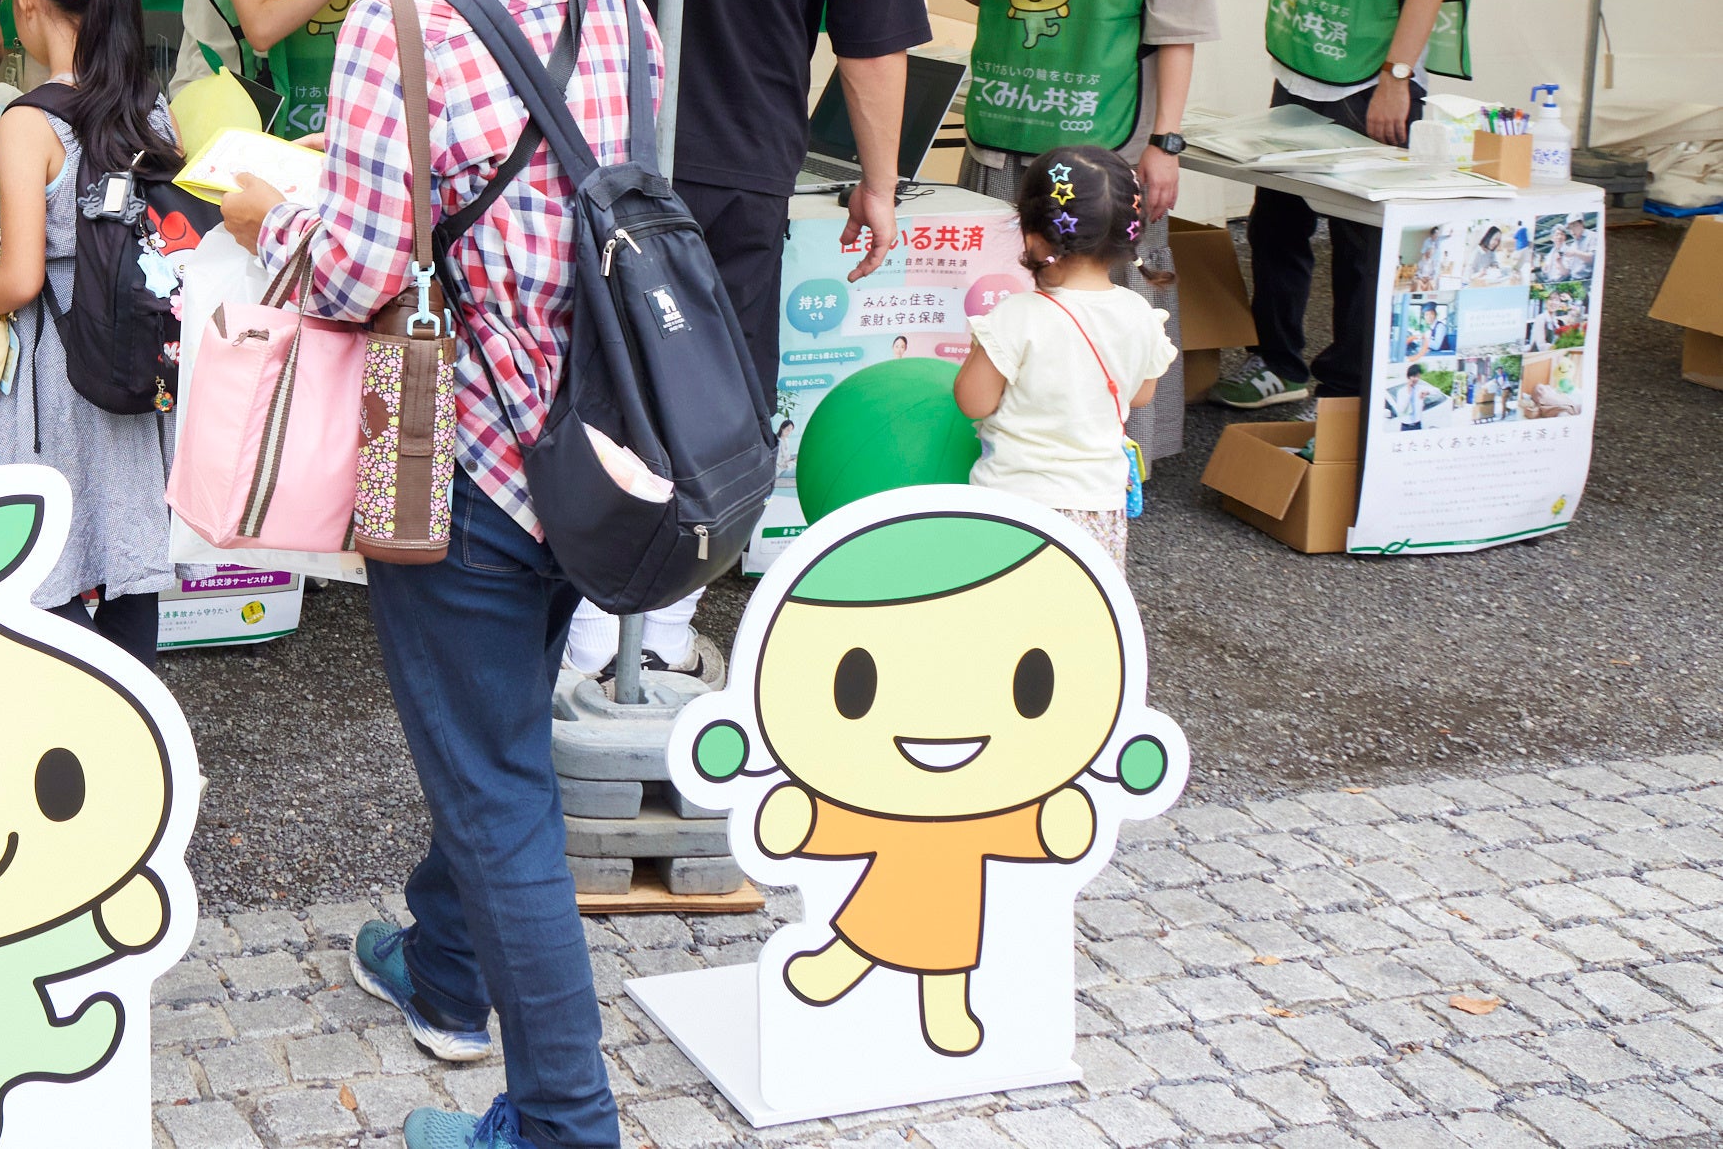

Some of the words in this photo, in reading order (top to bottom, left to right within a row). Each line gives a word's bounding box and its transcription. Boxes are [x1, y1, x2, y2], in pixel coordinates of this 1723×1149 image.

[1312, 42, 1348, 61] coop
[1059, 119, 1094, 134] coop
[798, 294, 838, 310] 持ち家
[863, 293, 945, 308] みんなの住宅と
[809, 311, 825, 321] でも
[860, 312, 946, 327] 家財を守る保障
